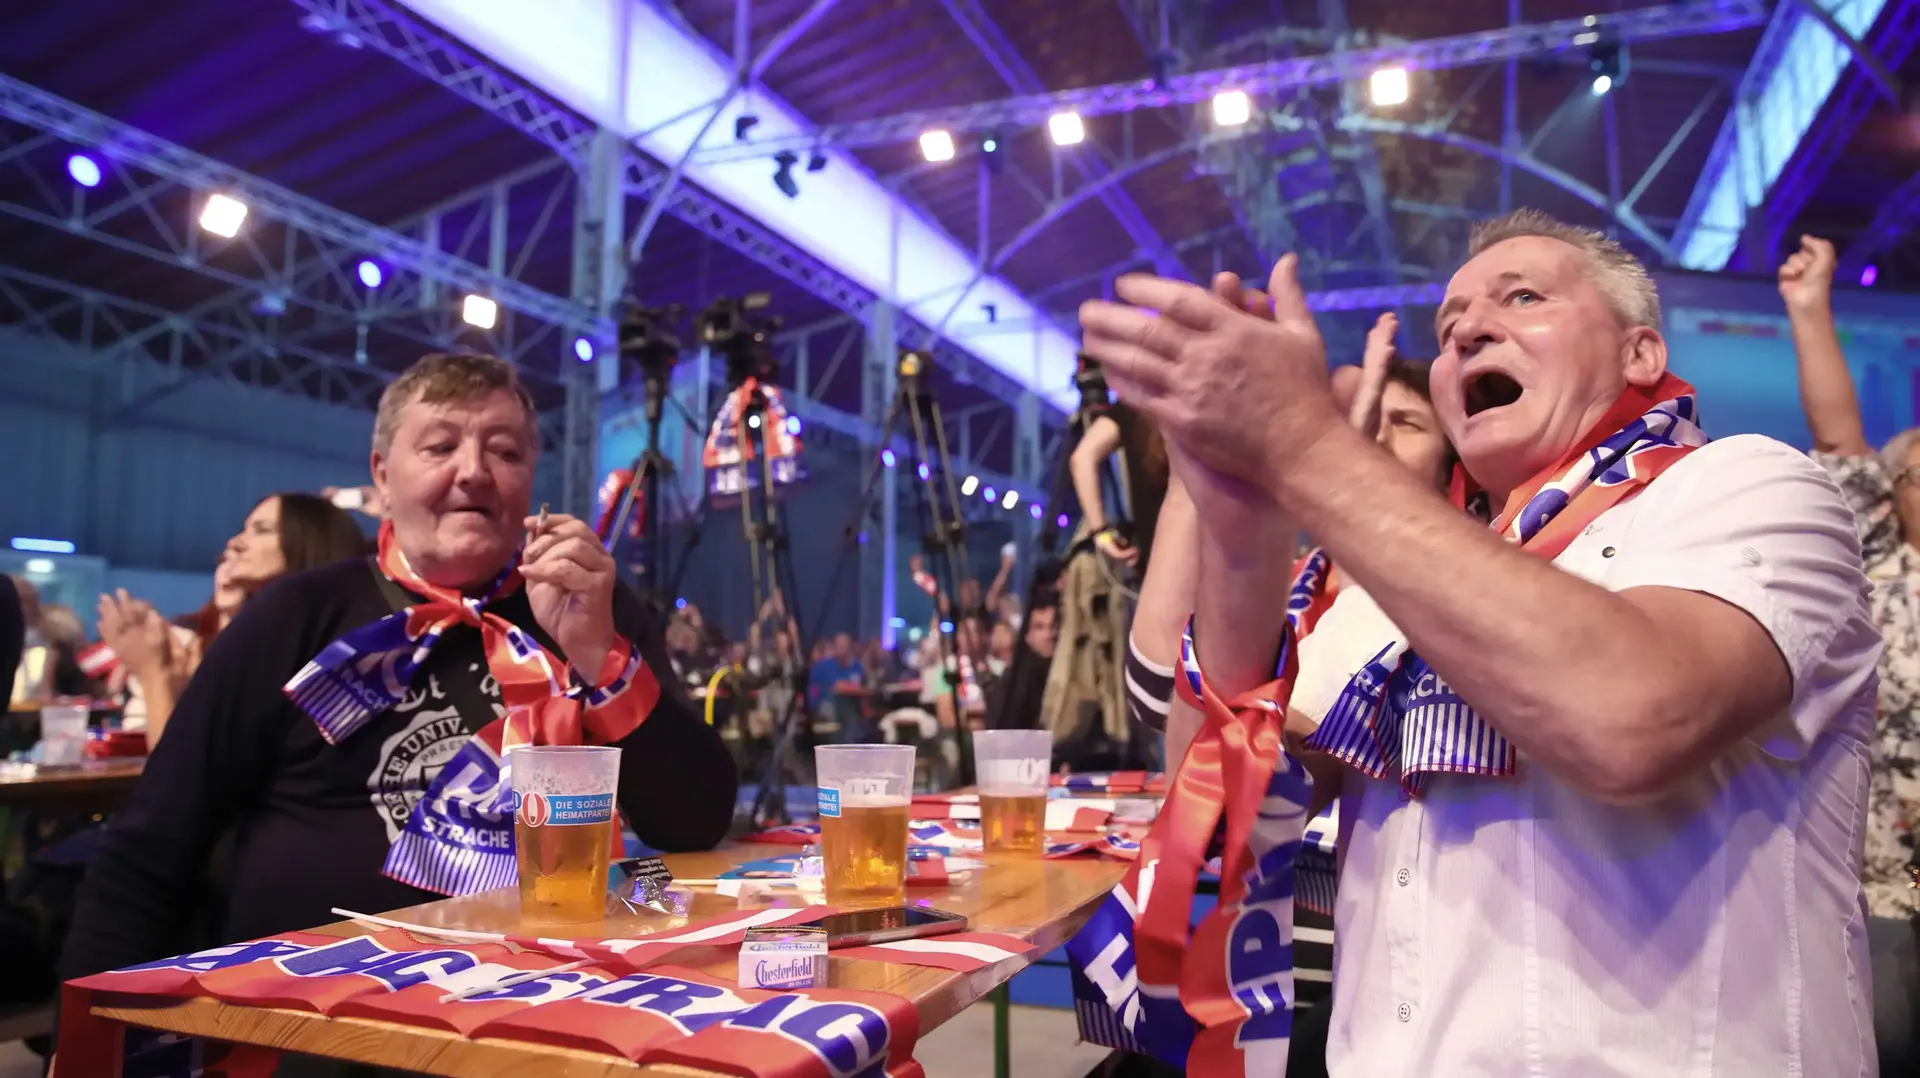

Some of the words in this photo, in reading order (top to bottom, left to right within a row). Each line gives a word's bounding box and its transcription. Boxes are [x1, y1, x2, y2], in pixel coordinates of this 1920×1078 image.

[555, 800, 573, 810] DIE
[576, 798, 612, 809] SOZIALE
[421, 815, 511, 849] STRACHE
[755, 955, 812, 988] Chesterfield
